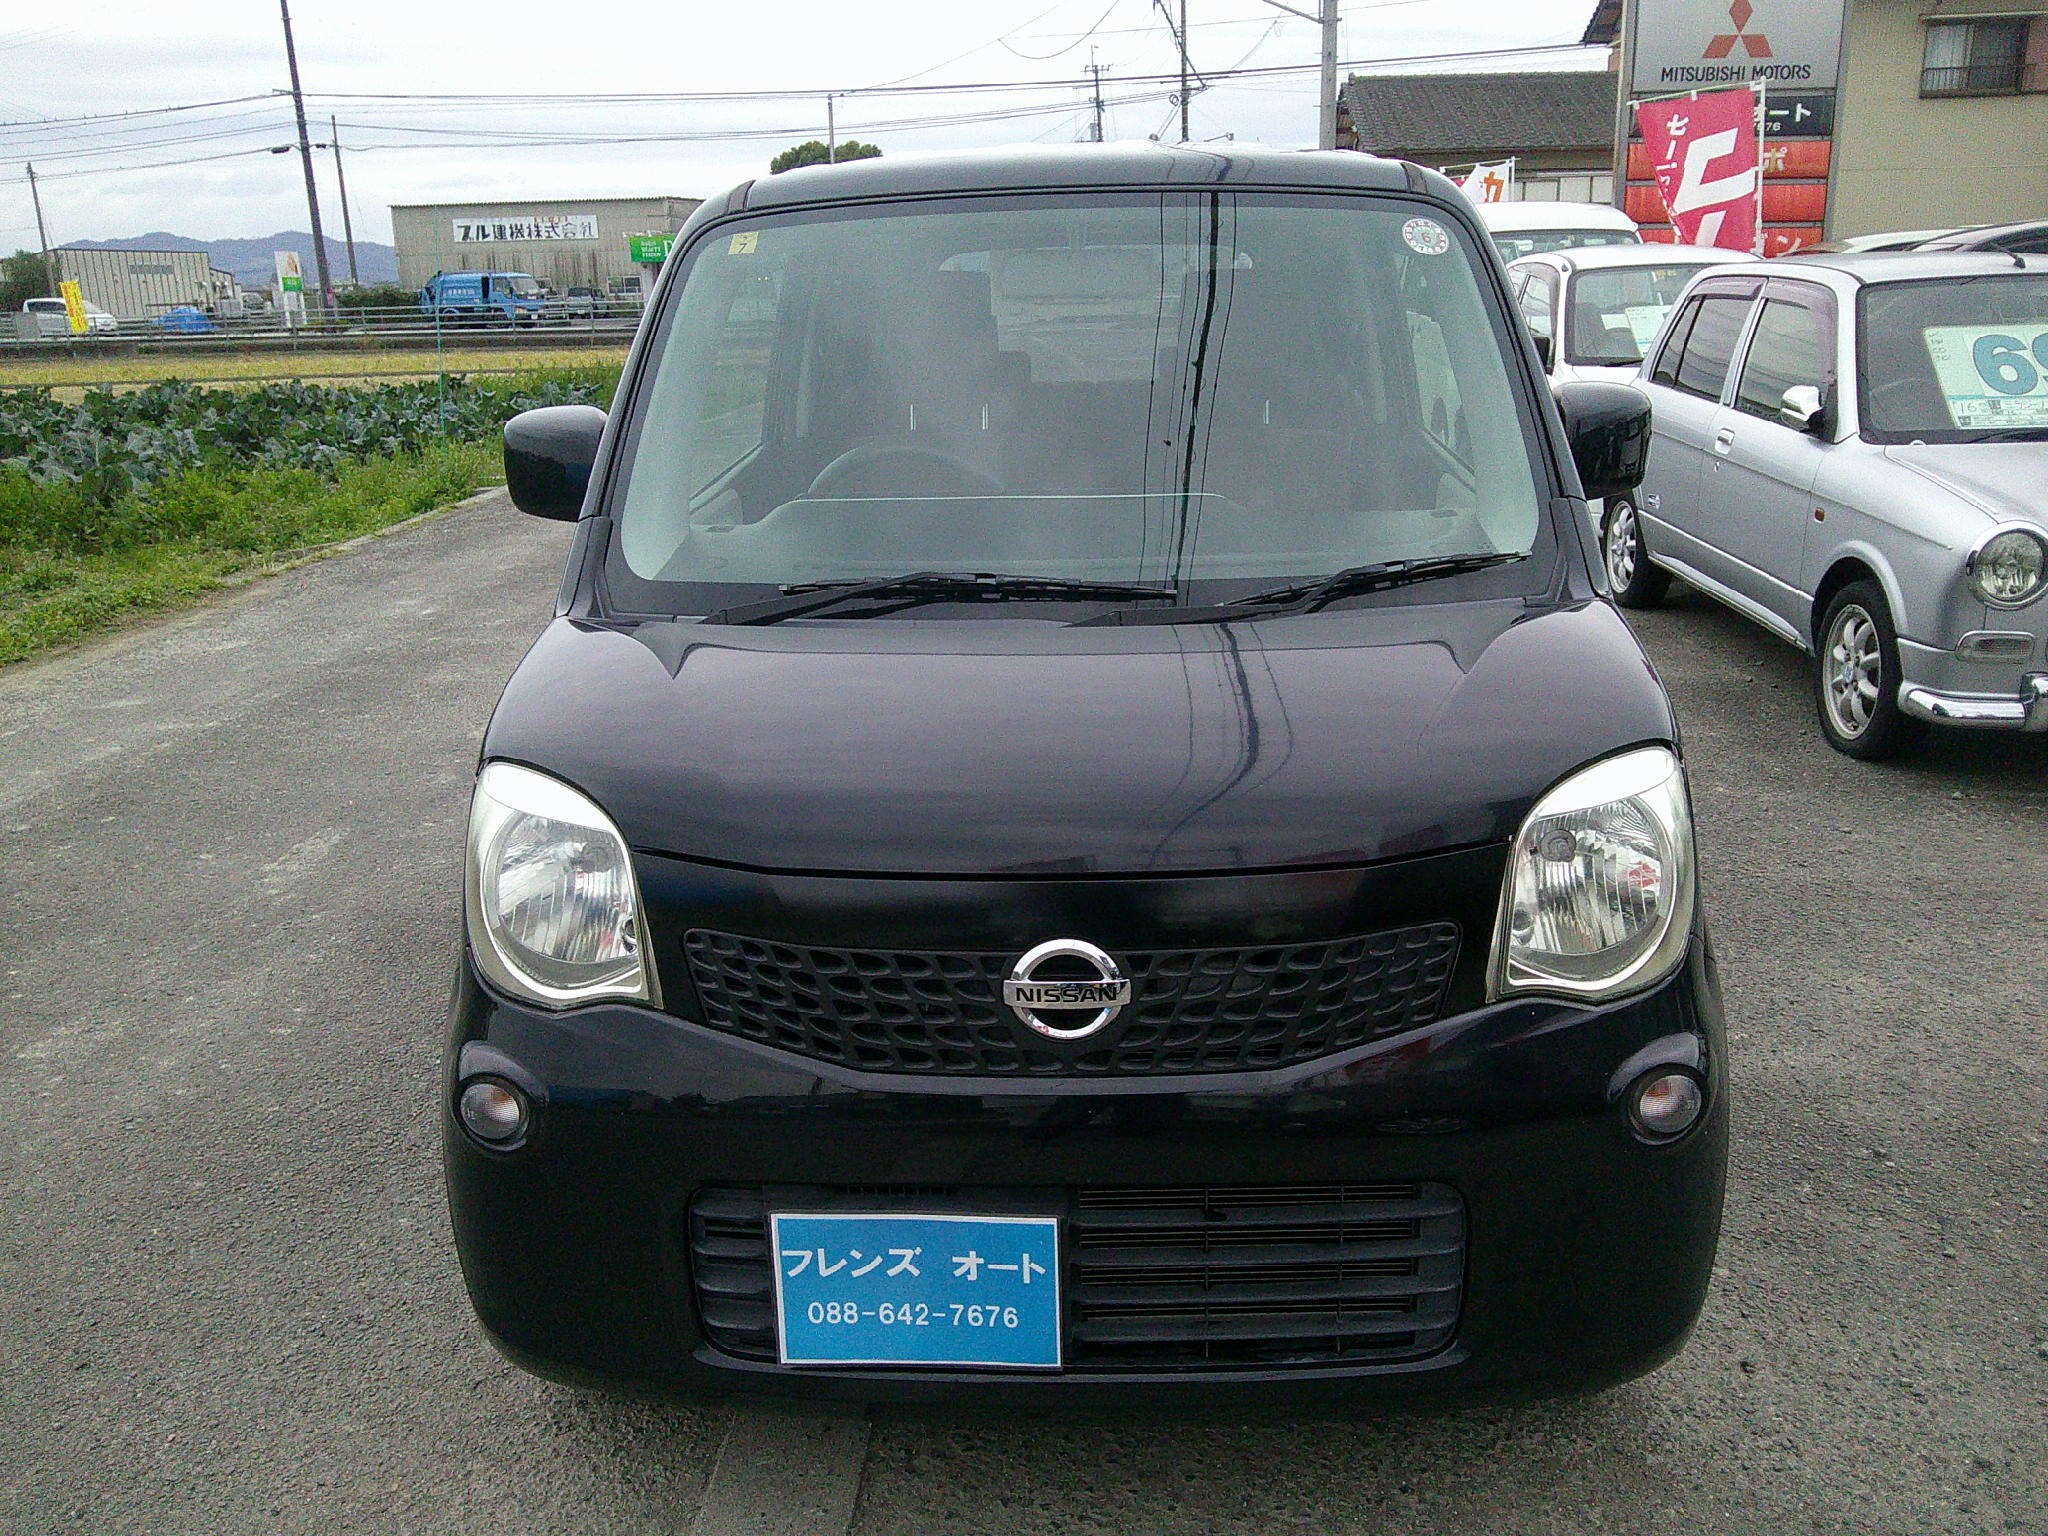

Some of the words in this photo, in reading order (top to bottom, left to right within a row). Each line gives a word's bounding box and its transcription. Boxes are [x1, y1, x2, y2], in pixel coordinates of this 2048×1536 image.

[1661, 66, 1745, 82] MITSUBISHI
[1752, 64, 1811, 80] MOTORS
[1015, 986, 1117, 1003] NISSAN
[781, 1246, 922, 1278] フレンズ
[952, 1250, 1046, 1284] オート
[807, 1301, 1019, 1328] 088-642-7676
